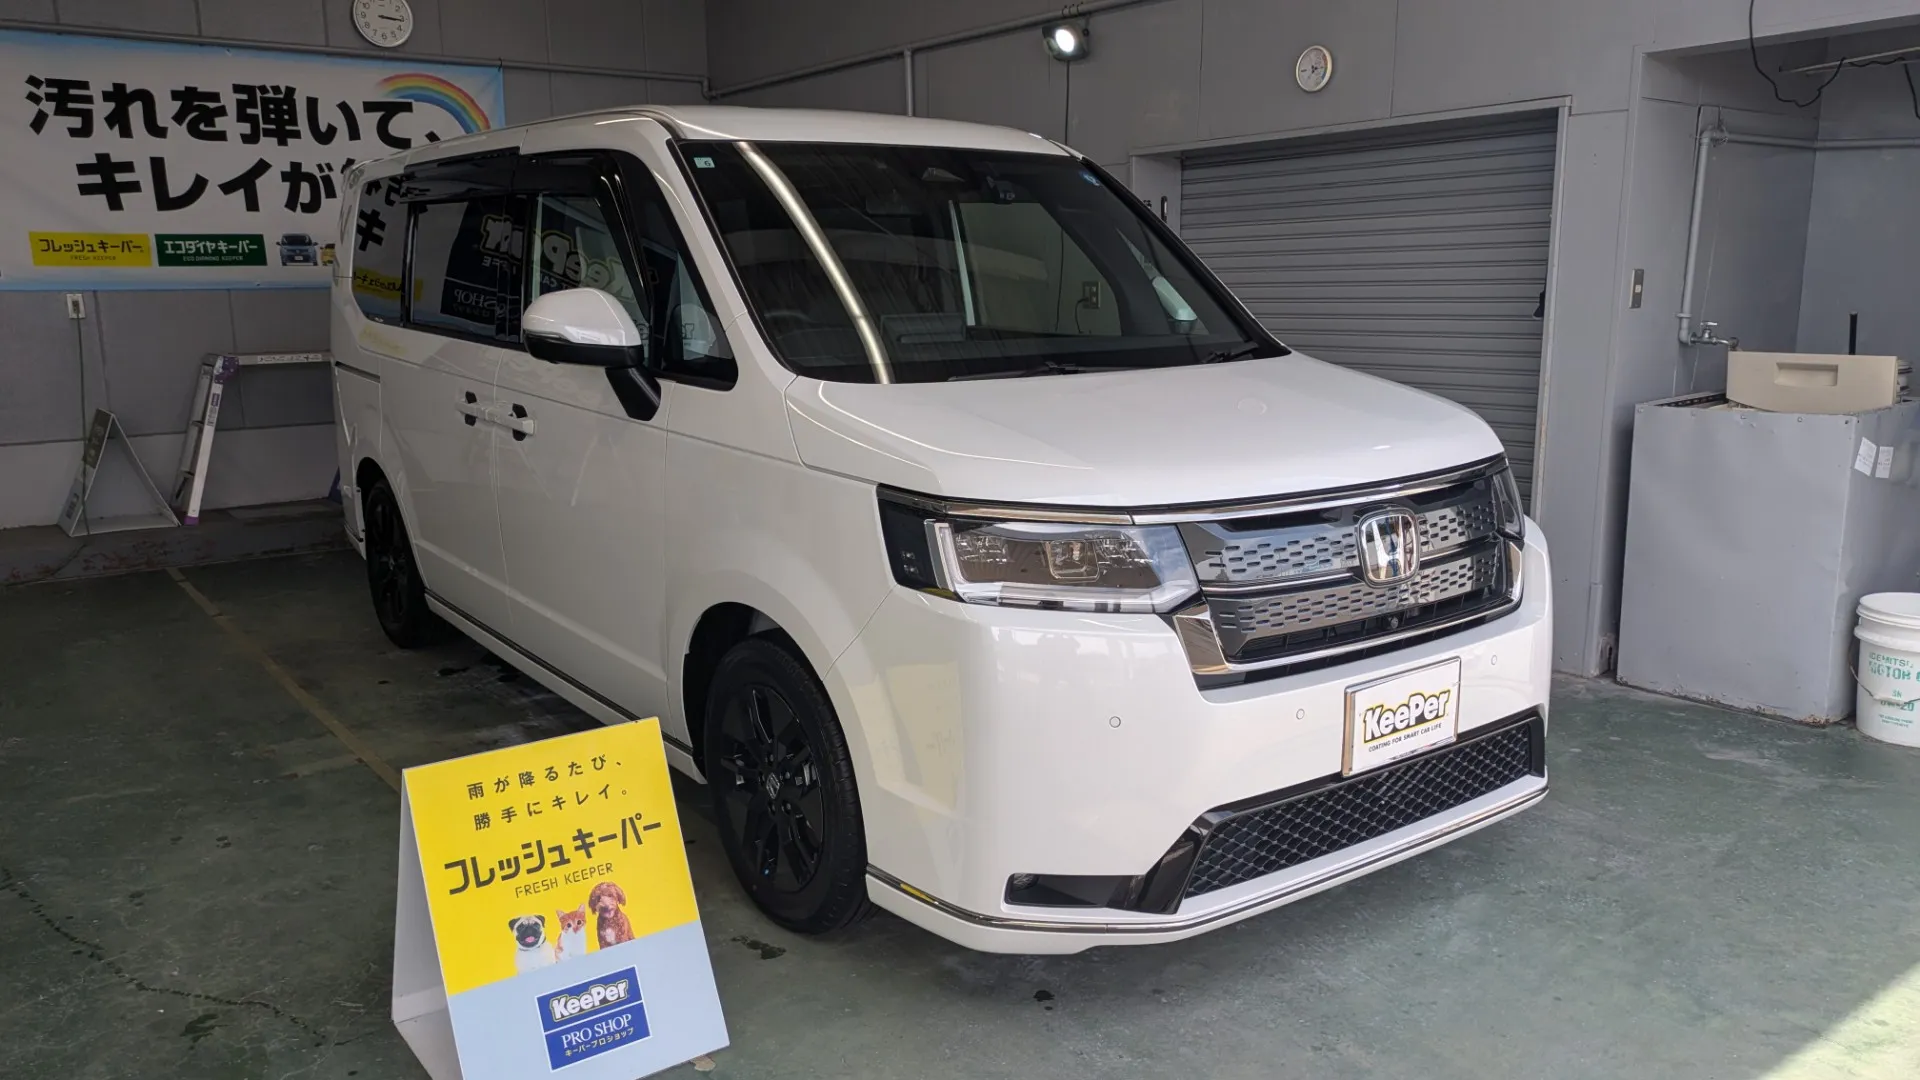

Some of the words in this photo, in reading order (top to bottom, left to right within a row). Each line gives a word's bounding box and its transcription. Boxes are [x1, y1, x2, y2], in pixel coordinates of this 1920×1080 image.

[360, 11, 367, 19] 9
[364, 21, 371, 29] 8
[381, 32, 388, 40] 6
[25, 75, 441, 149] 汚れを弾いて、
[76, 153, 356, 213] キレイが
[163, 240, 258, 254] エコダイヤキーパー
[1363, 689, 1450, 743] KeePer
[1368, 740, 1391, 752] COATING
[1392, 736, 1402, 745] FOR
[1403, 730, 1419, 741] SMART
[1420, 726, 1430, 734] CAR
[1431, 722, 1442, 731] LIFE
[467, 754, 622, 800] 雨が降るたび、
[474, 784, 627, 831] 勝手にキレイ。
[444, 812, 662, 895] フレッシュキーパー
[515, 876, 559, 898] FRESH
[564, 862, 613, 884] KEEPER
[550, 980, 628, 1021] KeePer
[561, 1027, 592, 1048] PRO
[594, 1013, 632, 1037] SHOP
[565, 1027, 634, 1057] キーパープロショップ
